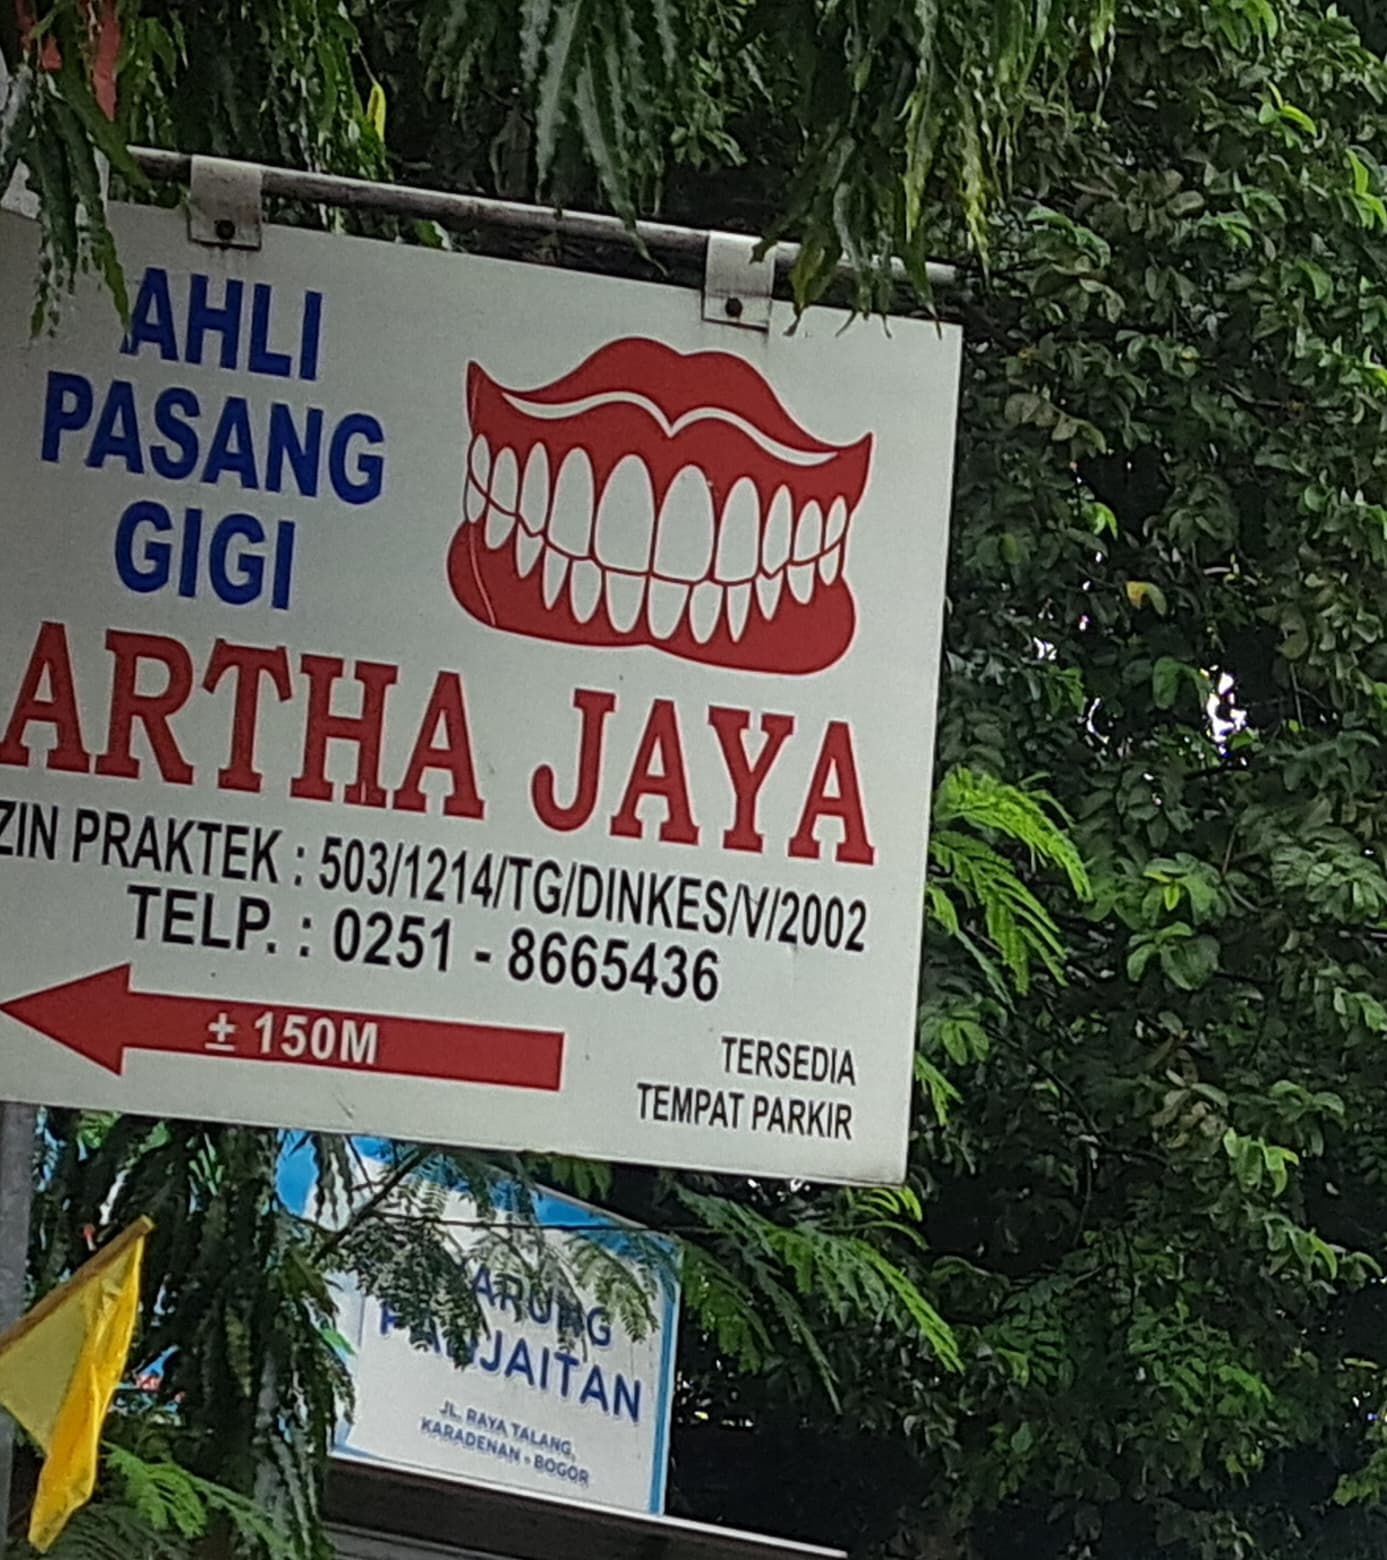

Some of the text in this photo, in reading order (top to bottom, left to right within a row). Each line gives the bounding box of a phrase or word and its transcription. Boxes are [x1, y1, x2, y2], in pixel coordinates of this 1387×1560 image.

[123, 268, 322, 381] AHLI
[41, 370, 386, 505] PASANG
[115, 501, 295, 609] GIGI
[0, 622, 876, 866] ARTHA JAYA
[0, 800, 58, 861] ZIN
[72, 808, 282, 884] PRAKTEK
[319, 836, 868, 952] 503/1214/TG/DINKES/V/2002
[127, 884, 278, 955] TELP.
[334, 907, 453, 972] 0251
[507, 926, 720, 1003] 8665436
[253, 1010, 380, 1066] 150M
[721, 1036, 856, 1087] TERSEDIA
[637, 1082, 852, 1141] TEMPAT PARKIR
[468, 1263, 613, 1347] ARUNG
[421, 1417, 520, 1463] KARADENAN
[533, 1453, 590, 1486] BOGOR
[440, 1400, 577, 1463] JL. RAYA TALANG,
